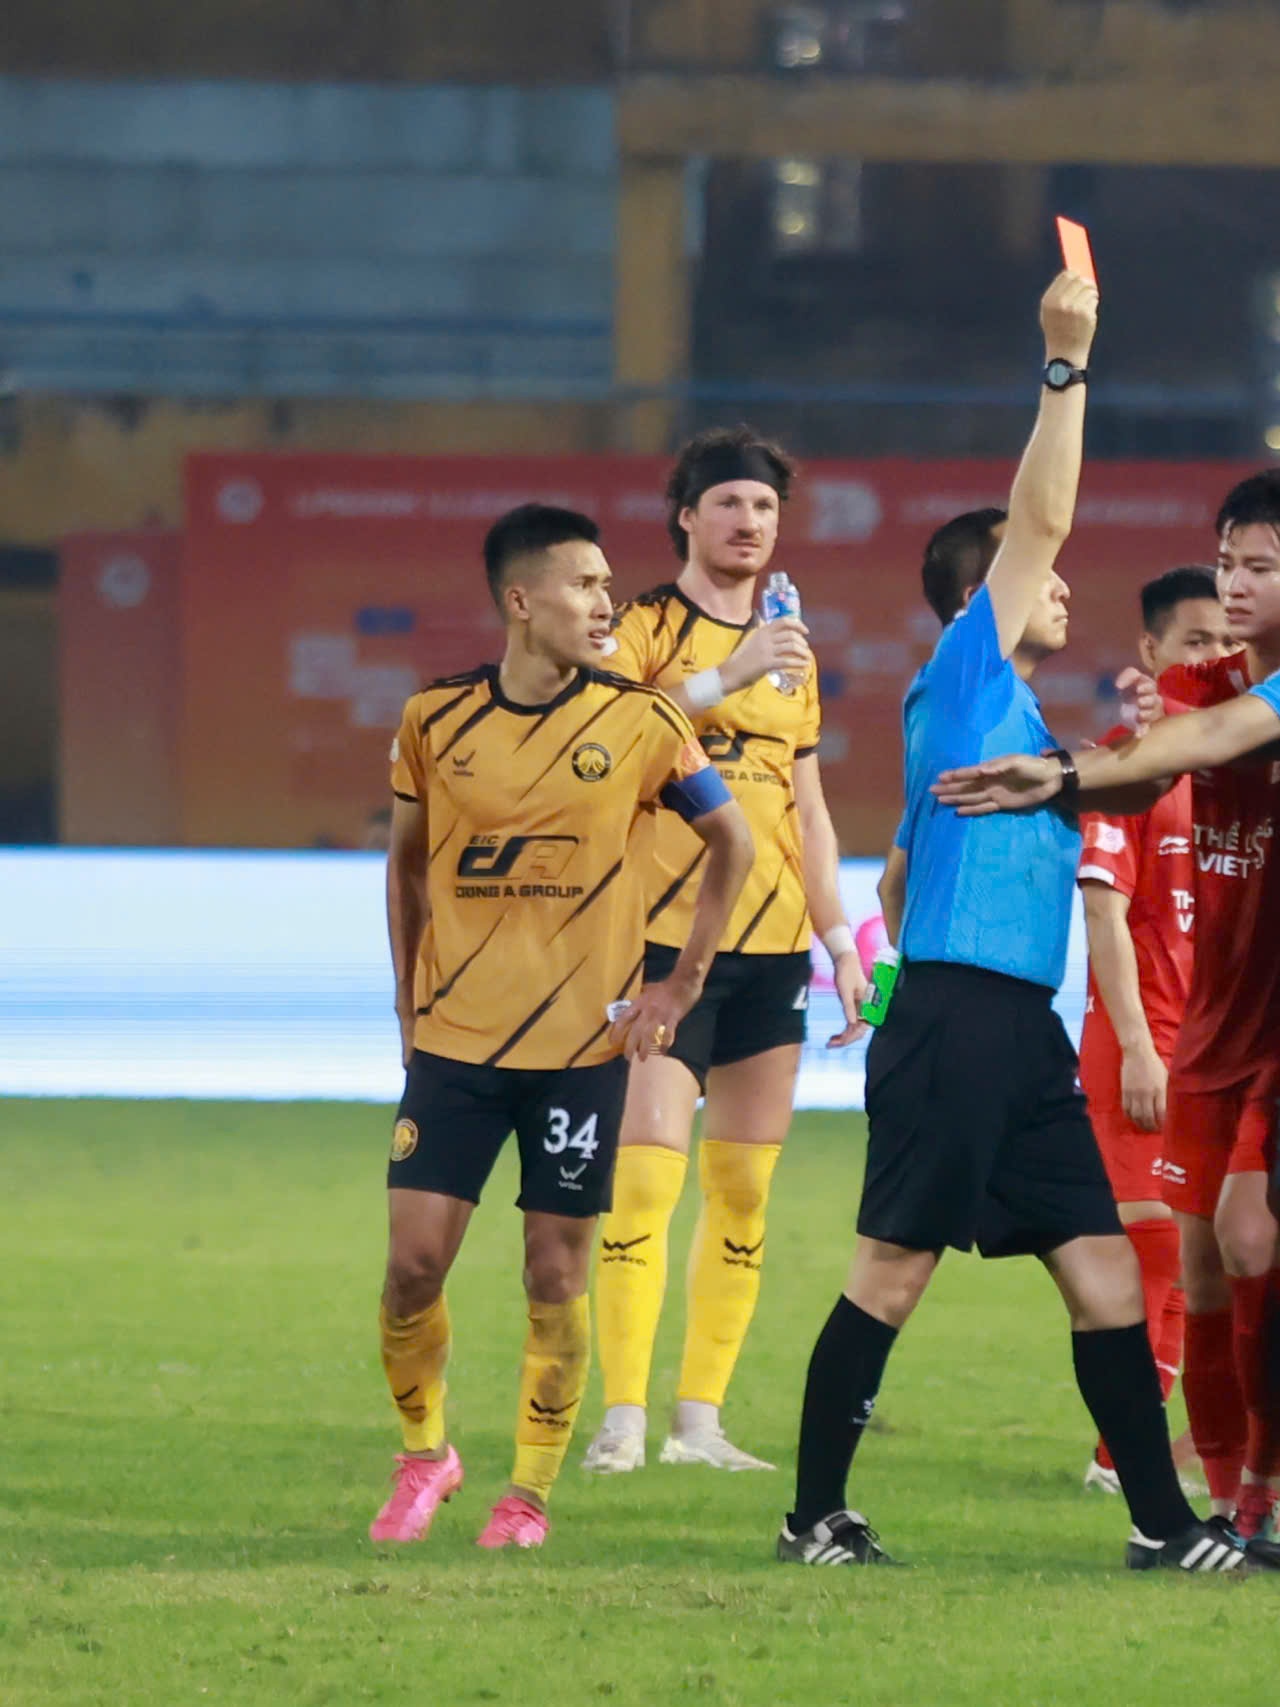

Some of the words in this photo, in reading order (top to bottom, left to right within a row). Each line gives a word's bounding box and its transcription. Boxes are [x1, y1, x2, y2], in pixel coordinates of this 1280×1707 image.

[503, 885, 516, 898] A
[519, 885, 584, 898] GROUP
[1171, 889, 1195, 910] TH
[543, 1106, 600, 1160] 34
